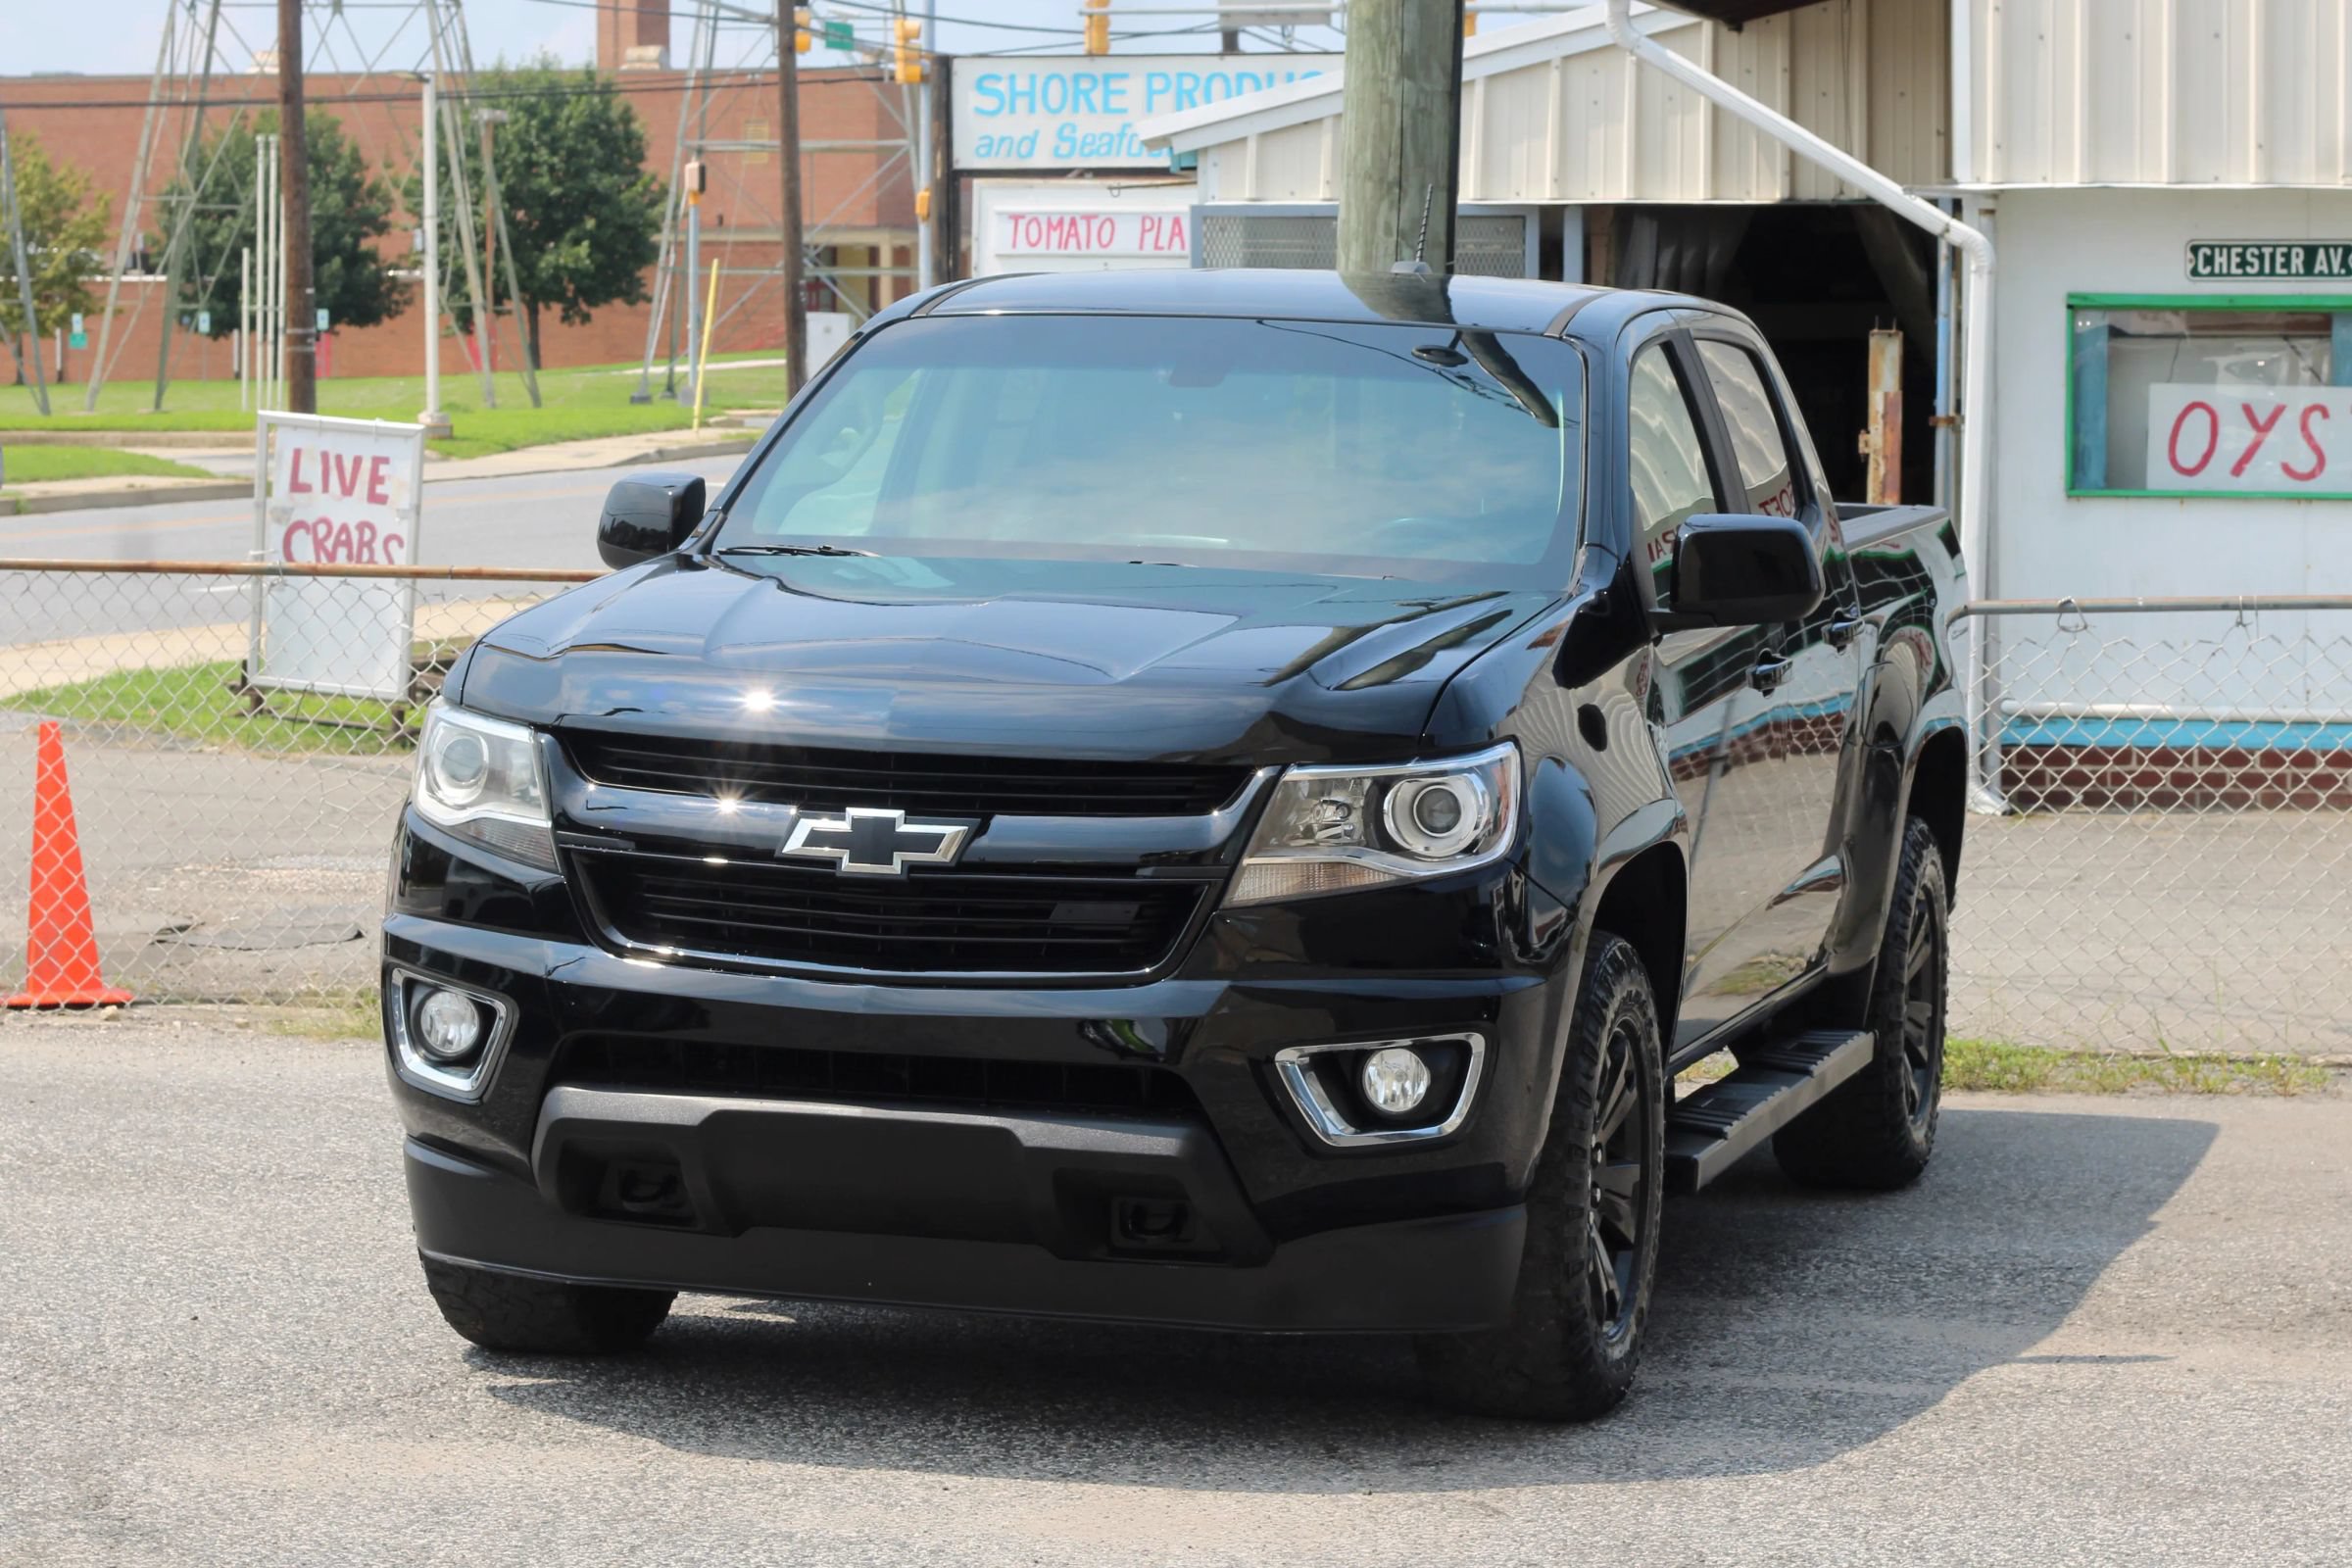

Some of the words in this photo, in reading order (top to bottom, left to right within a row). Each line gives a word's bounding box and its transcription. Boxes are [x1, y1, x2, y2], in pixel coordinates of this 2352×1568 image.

[973, 72, 1130, 116] SHORE
[1145, 70, 1324, 114] PROD
[974, 128, 1040, 160] and
[1053, 122, 1163, 159] Seafo
[1008, 214, 1116, 250] TOMATO
[1138, 215, 1187, 252] PLA
[2197, 247, 2305, 275] CHESTER
[2314, 247, 2346, 275] AV.
[2168, 400, 2352, 481] OYS
[289, 448, 390, 505] LIVE
[282, 516, 405, 564] CRABS
